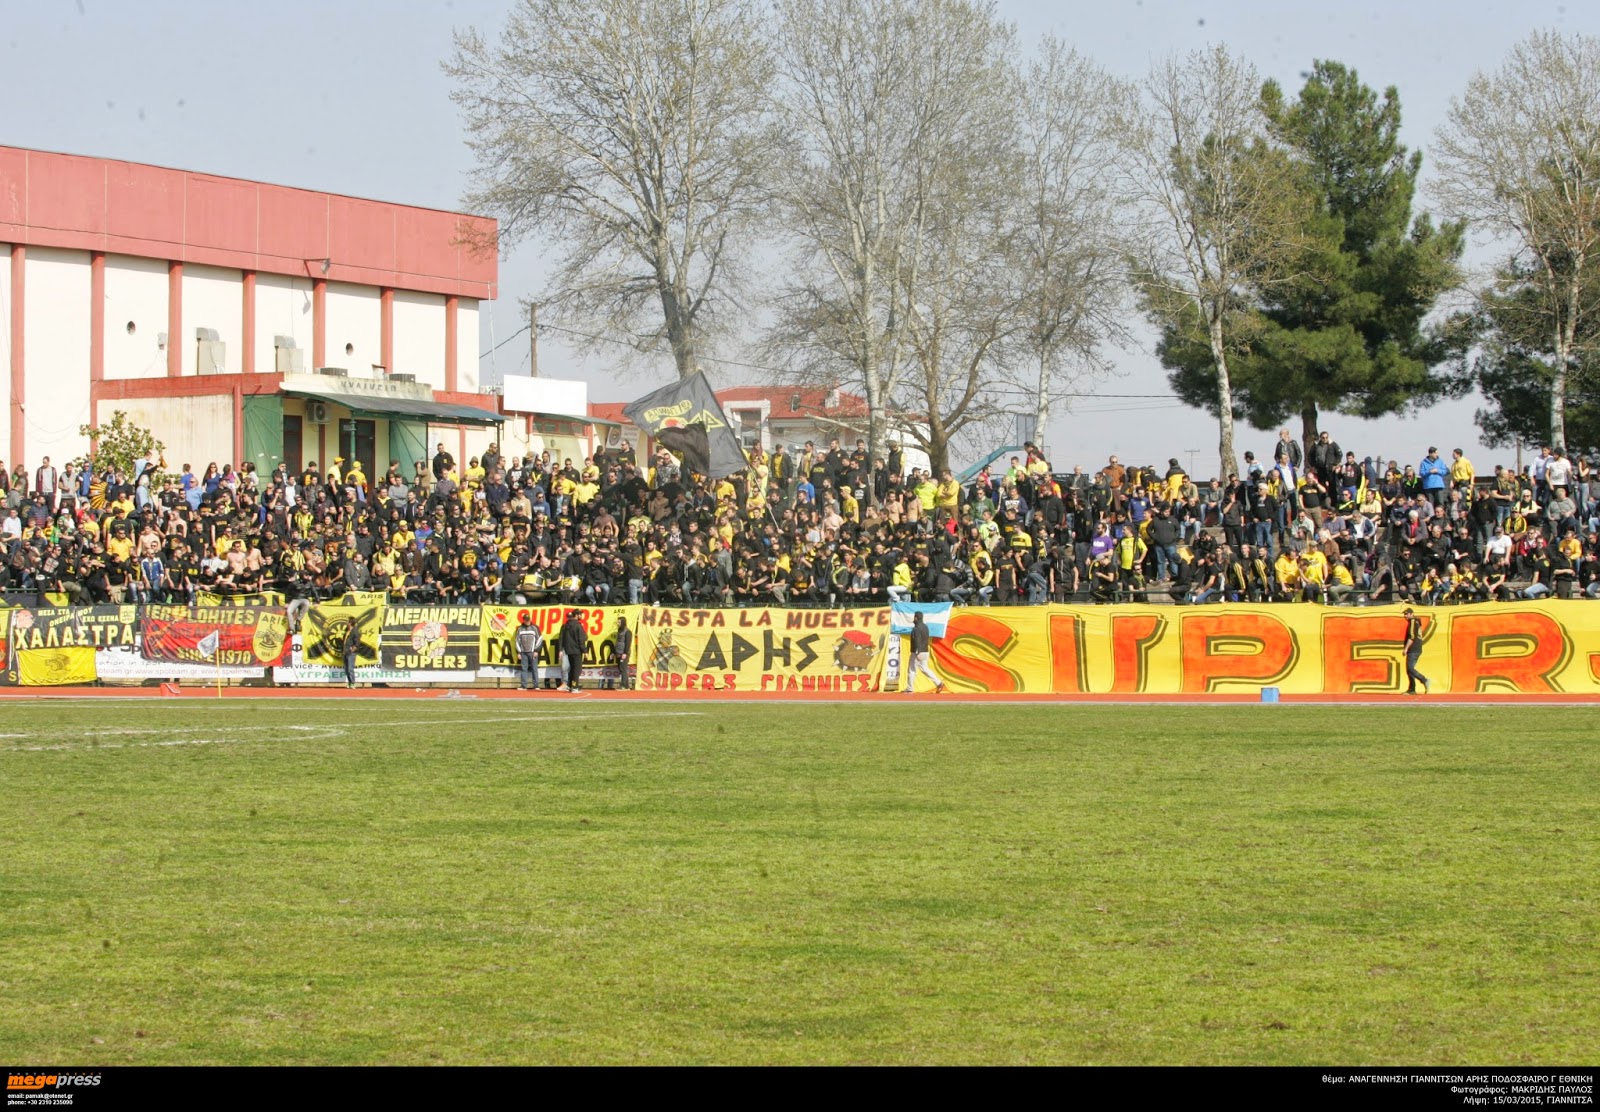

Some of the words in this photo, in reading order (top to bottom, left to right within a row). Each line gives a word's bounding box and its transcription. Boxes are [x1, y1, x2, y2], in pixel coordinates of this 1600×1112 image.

[58, 608, 70, 616] ΣΤΑ
[385, 608, 480, 626] ΑΛΕΞΑΝΔΡΕΙΑ
[642, 608, 725, 627] HASTA
[739, 610, 772, 627] LA
[786, 610, 891, 629] MUERTE
[15, 624, 135, 649] ΧΑΛΑΣΤΡΑ
[221, 650, 251, 664] 1970
[930, 608, 1575, 693] SUPER
[395, 655, 467, 668] SUPER3
